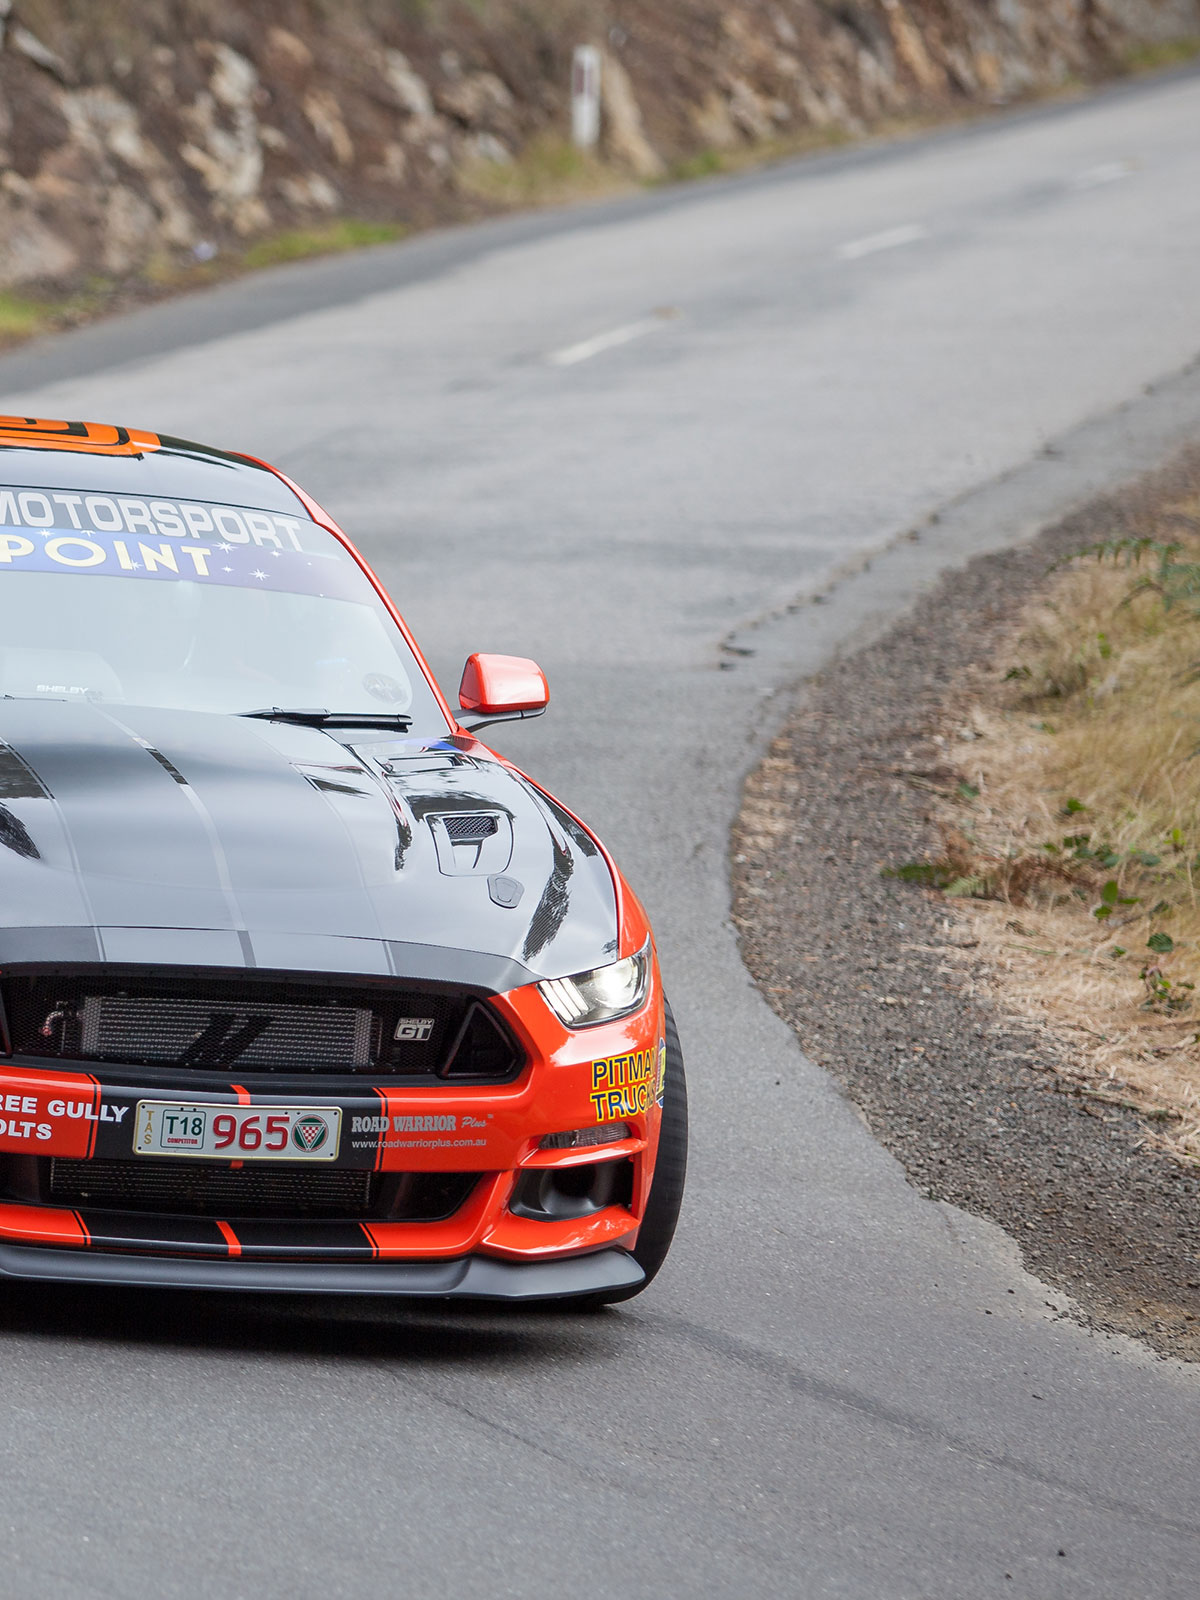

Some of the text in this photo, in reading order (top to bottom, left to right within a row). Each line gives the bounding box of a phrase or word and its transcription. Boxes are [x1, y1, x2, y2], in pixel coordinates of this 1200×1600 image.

[397, 1024, 432, 1039] GT
[47, 1099, 130, 1123] GULLY
[166, 1115, 203, 1136] T18
[213, 1114, 290, 1150] 965
[351, 1116, 390, 1132] ROAD
[393, 1115, 456, 1132] WARRIOR
[167, 1137, 198, 1145] COMPETITOR
[352, 1138, 487, 1149] www.roadwarriorplus.com.au
